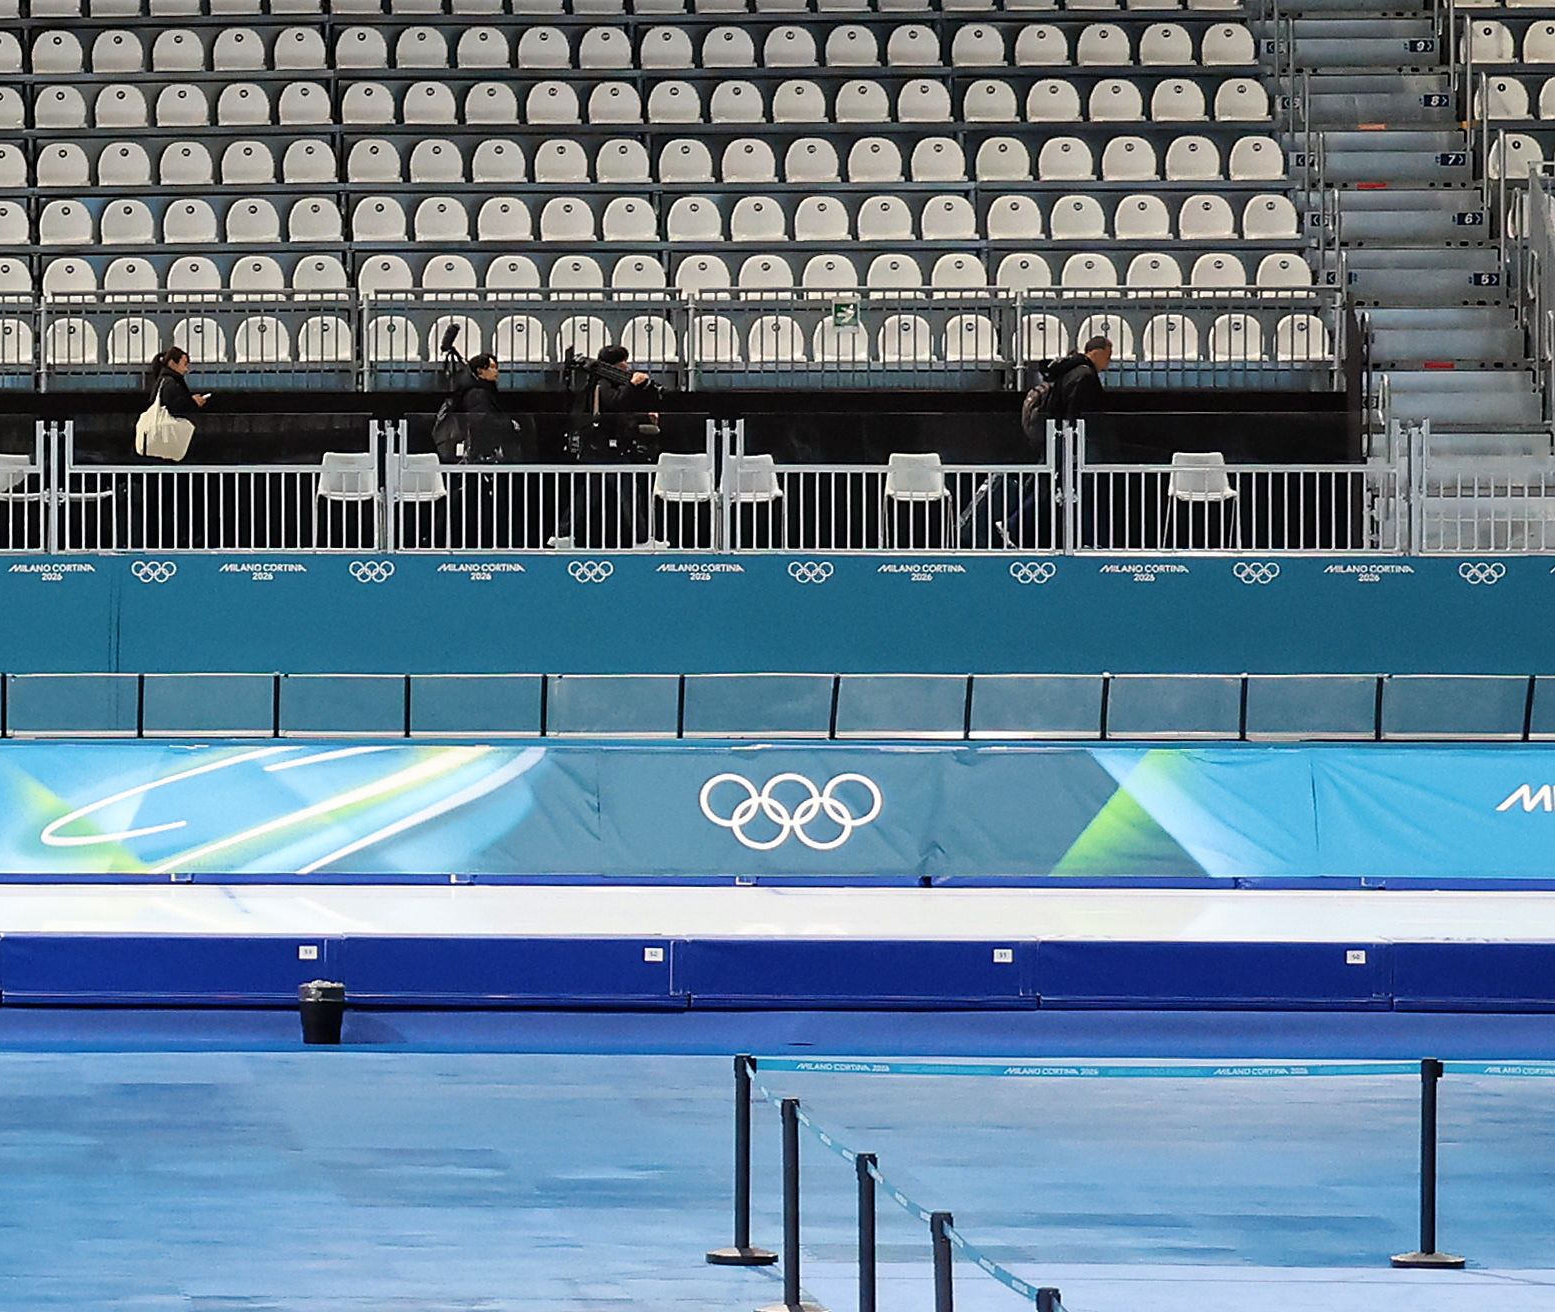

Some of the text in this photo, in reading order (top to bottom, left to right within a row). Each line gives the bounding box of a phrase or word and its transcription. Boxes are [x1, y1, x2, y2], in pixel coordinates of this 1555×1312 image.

[1448, 155, 1456, 165] 7
[1464, 214, 1472, 224] 6
[9, 563, 95, 573] MILANO CORTINA
[220, 563, 306, 572] MILANO CORTINA
[438, 563, 525, 572] MILANO CORTINA
[657, 563, 744, 573] MILANO CORTINA
[878, 563, 965, 573] MILANO CORTINA
[1100, 564, 1189, 574] MILANO CORTINA
[1324, 564, 1414, 574] MILANO CORTINA
[42, 572, 62, 581] 2026
[253, 571, 273, 581] 2026
[471, 570, 493, 581] 2026
[690, 572, 711, 581] 2026
[911, 571, 933, 582] 2026
[1134, 572, 1155, 582] 2026
[1359, 572, 1380, 582] 2026
[797, 1062, 832, 1071] MILANO
[1004, 1067, 1040, 1076] MILANO
[1214, 1067, 1249, 1076] MILANO
[1484, 1063, 1521, 1074] MILANO
